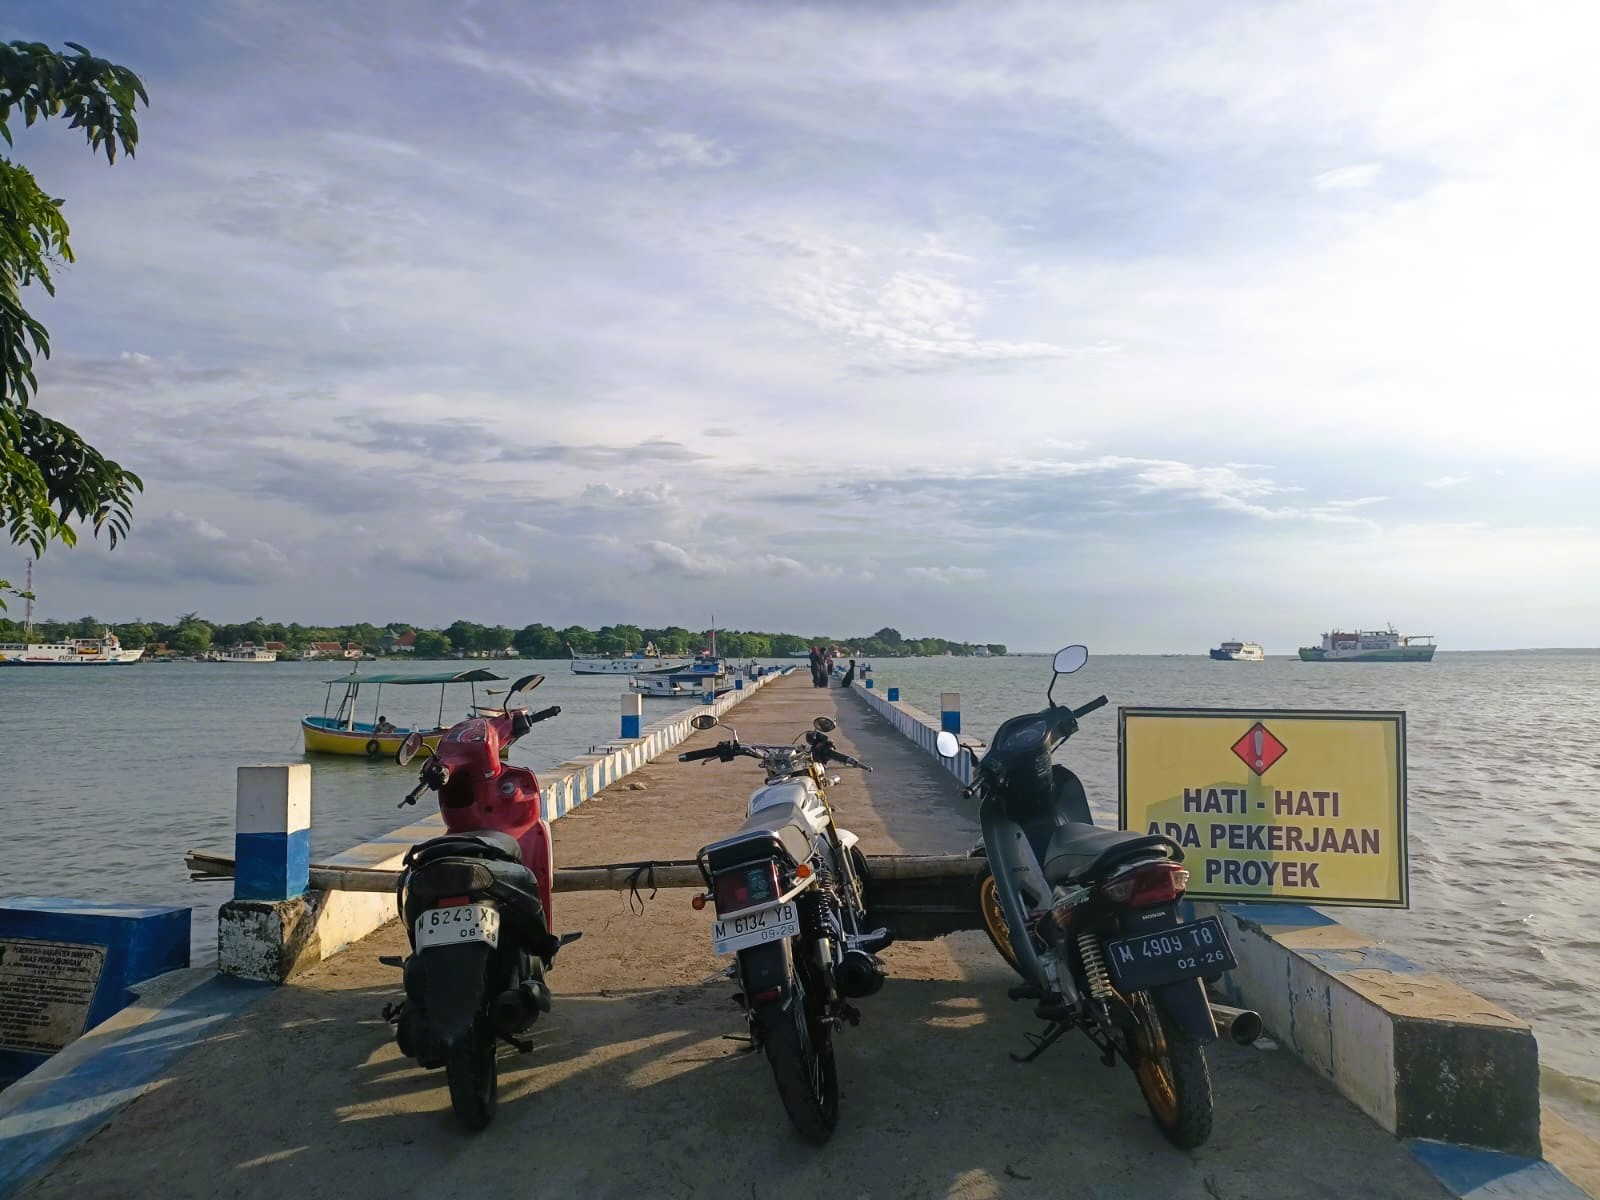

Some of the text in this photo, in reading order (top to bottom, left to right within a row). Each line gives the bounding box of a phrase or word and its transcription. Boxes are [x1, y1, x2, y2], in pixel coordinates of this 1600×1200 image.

[1183, 787, 1247, 814] HATI
[1274, 790, 1339, 817] HATI
[1210, 823, 1380, 854] PEKERJAAN
[1205, 859, 1320, 888] PROYEK
[431, 908, 473, 926] 6243
[715, 905, 793, 939] M 6134 YB
[1118, 945, 1135, 964] M
[1142, 936, 1183, 958] 4909
